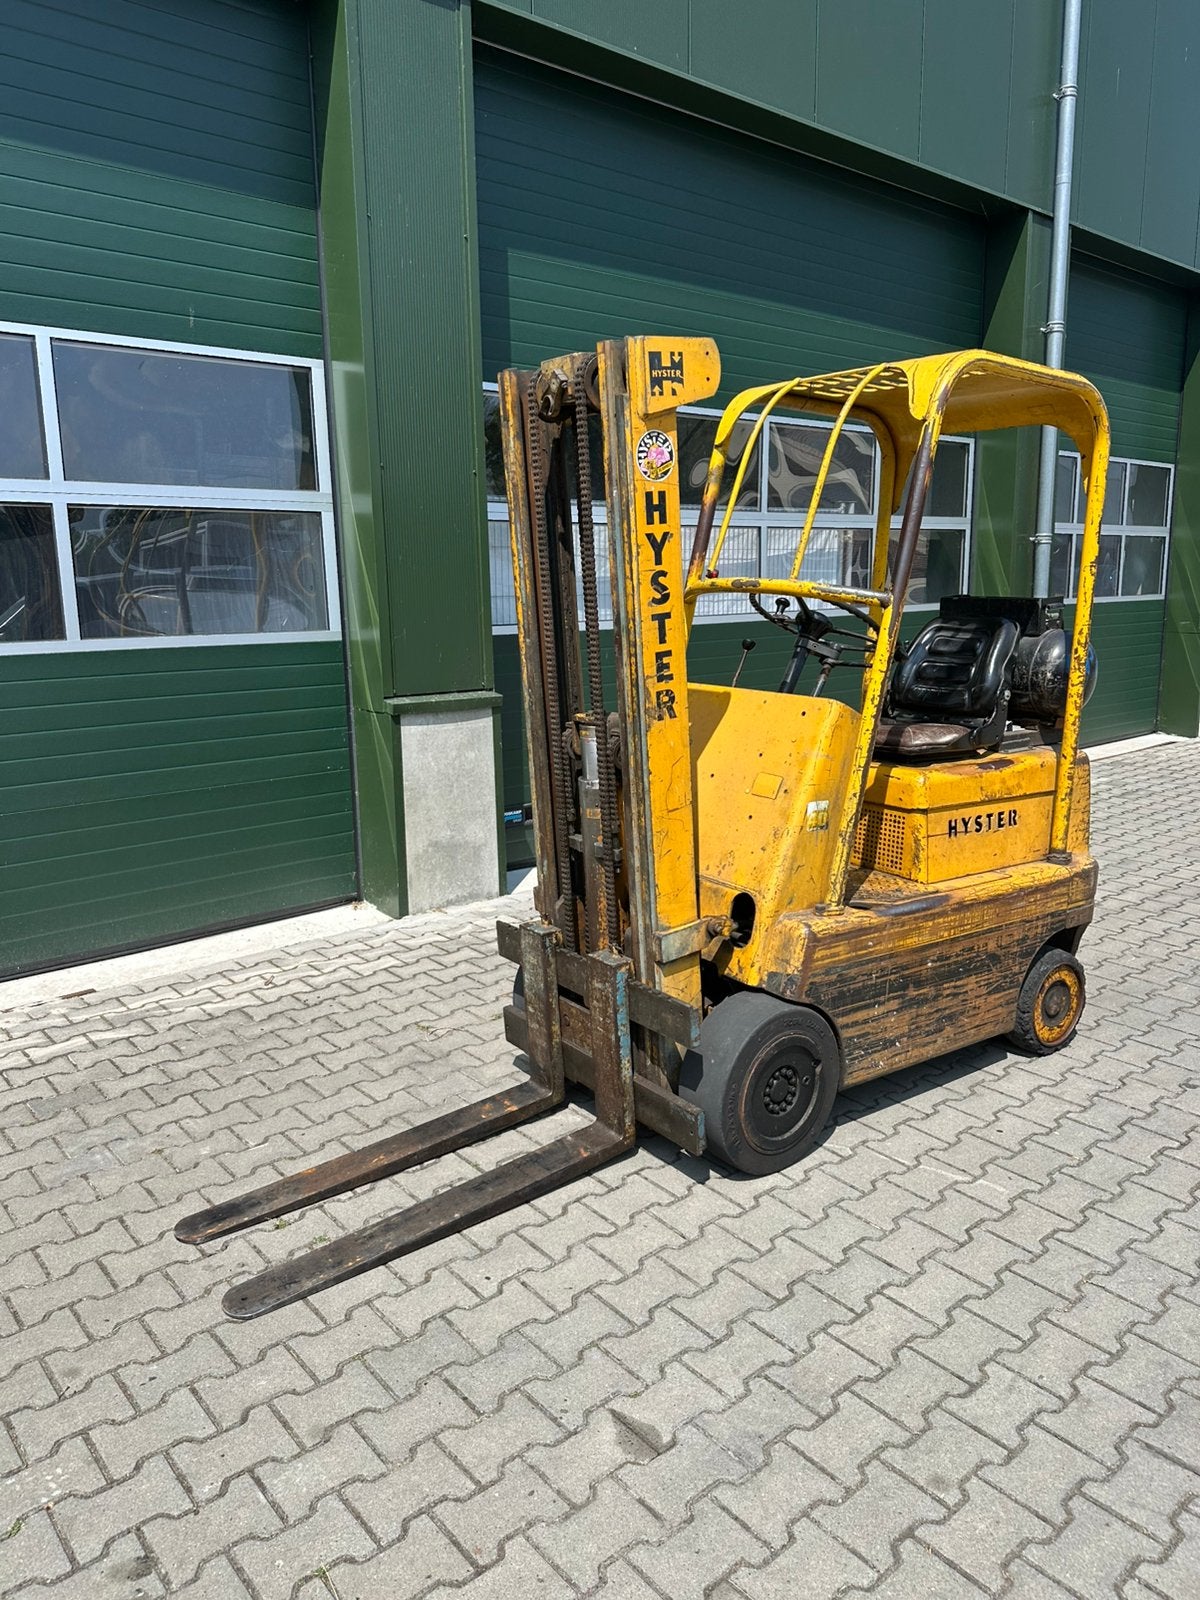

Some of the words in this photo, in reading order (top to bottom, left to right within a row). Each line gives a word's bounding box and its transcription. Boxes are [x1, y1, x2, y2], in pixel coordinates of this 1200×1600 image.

[651, 369, 684, 379] HYSTER
[644, 490, 678, 722] HYSTER
[948, 809, 1018, 838] HYSTER
